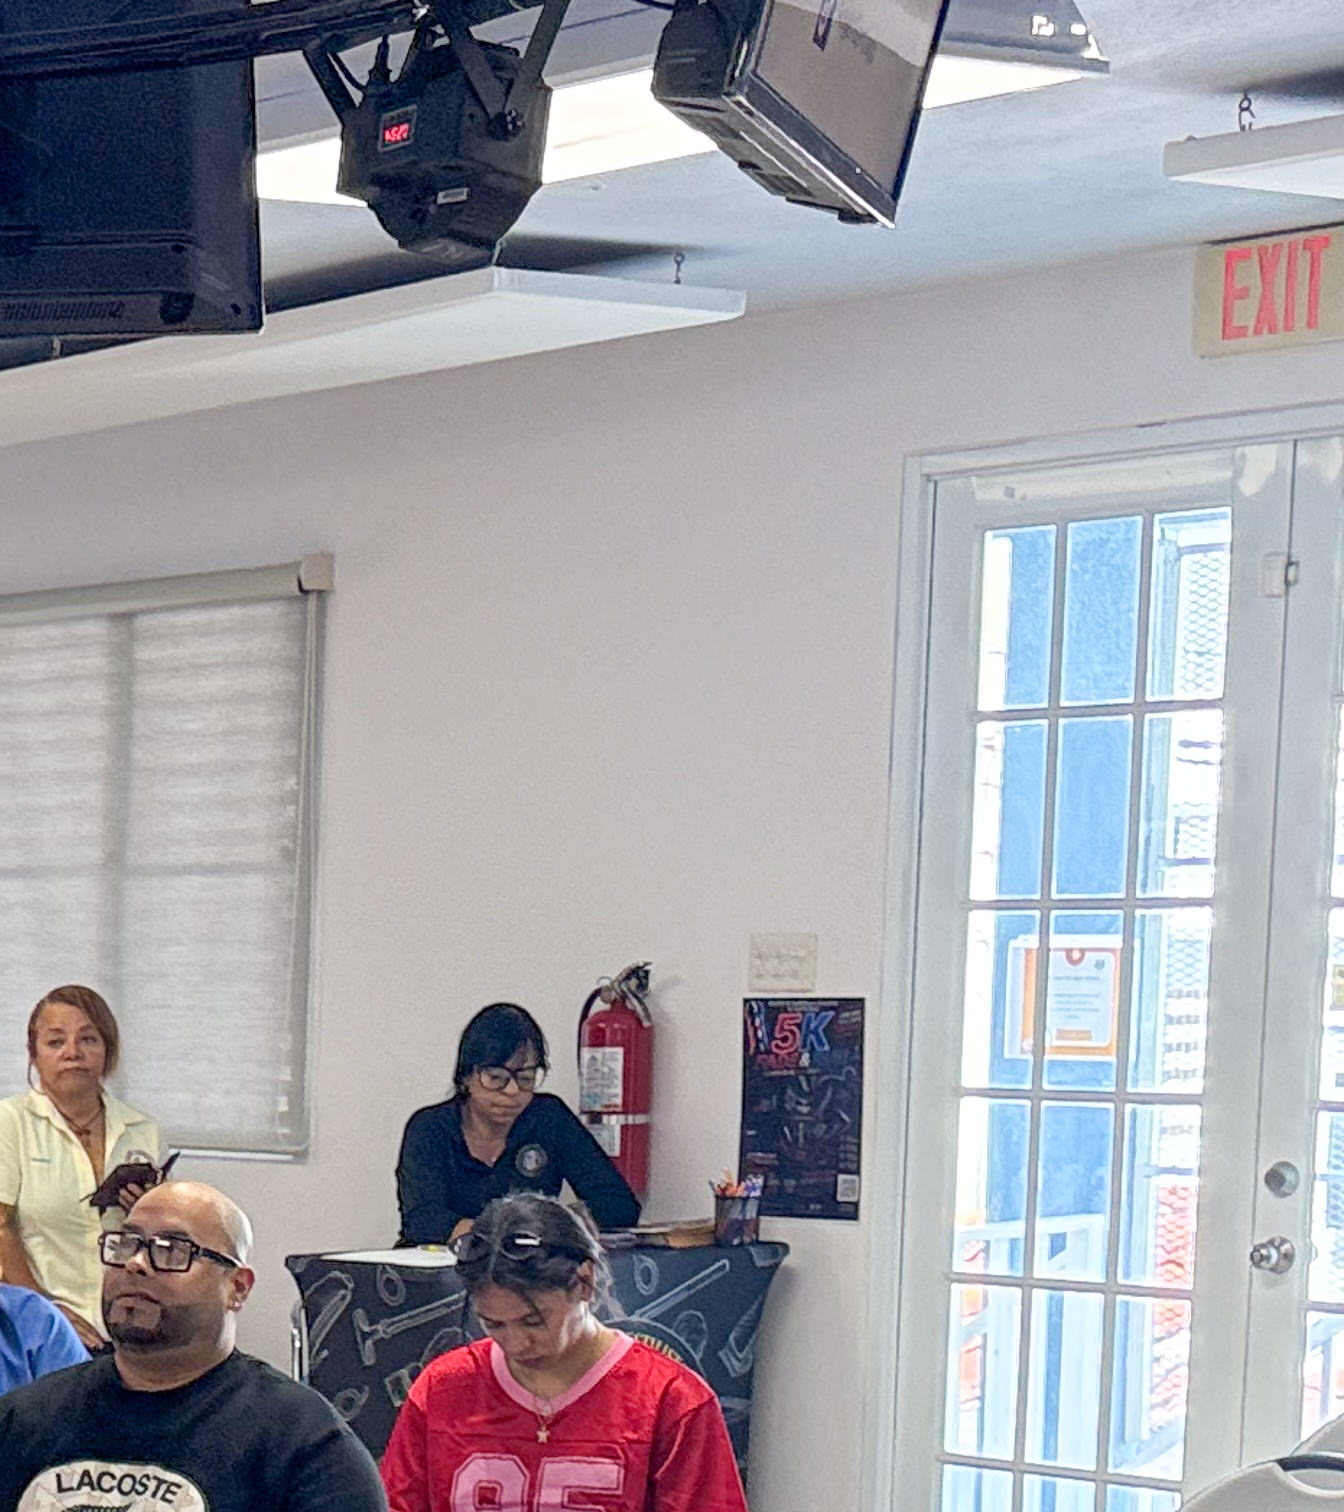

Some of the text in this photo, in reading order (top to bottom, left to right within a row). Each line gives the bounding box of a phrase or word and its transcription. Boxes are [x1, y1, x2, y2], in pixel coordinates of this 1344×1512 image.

[1221, 235, 1331, 341] EXIT
[770, 1010, 836, 1055] 5K
[55, 1469, 182, 1504] LACOSTE
